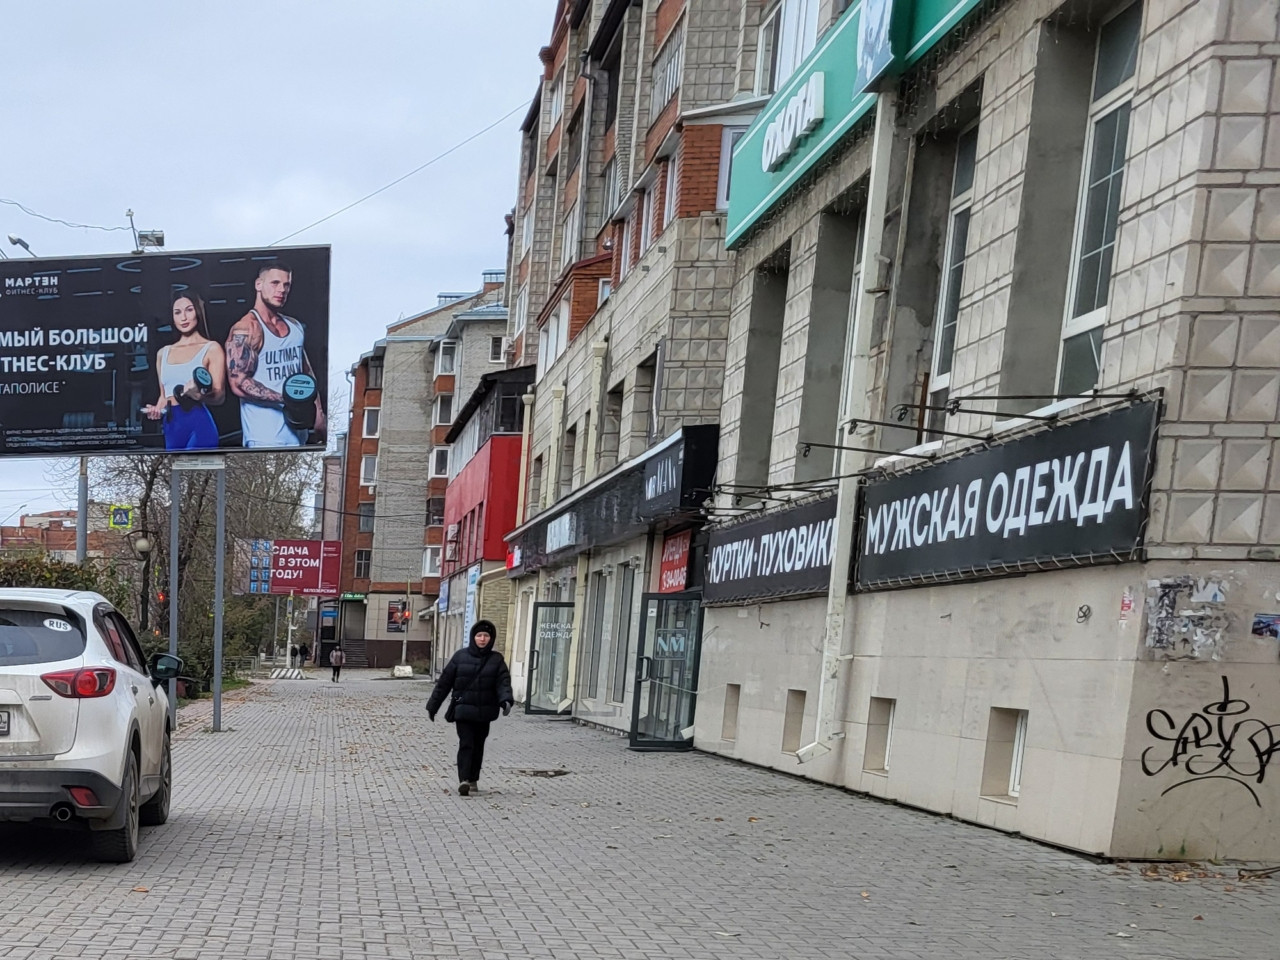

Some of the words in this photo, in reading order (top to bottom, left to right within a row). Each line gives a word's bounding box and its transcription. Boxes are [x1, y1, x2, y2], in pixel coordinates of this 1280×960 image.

[762, 71, 824, 173] ОХОТА
[5, 276, 58, 288] МАРТЭН
[5, 287, 58, 295] ФИТНЕС-КЛУБ
[48, 323, 148, 346] БОЛЬШОЙ
[865, 478, 982, 556] МУЖСКАЯ
[985, 440, 1133, 539] ОДЕЖДА
[271, 546, 309, 556] СДАЧА
[278, 558, 285, 567] В
[287, 558, 319, 568] ЭТОМ
[709, 537, 755, 584] КУРТКИ
[270, 569, 303, 580] ГОДУ!
[48, 620, 69, 631] RUS
